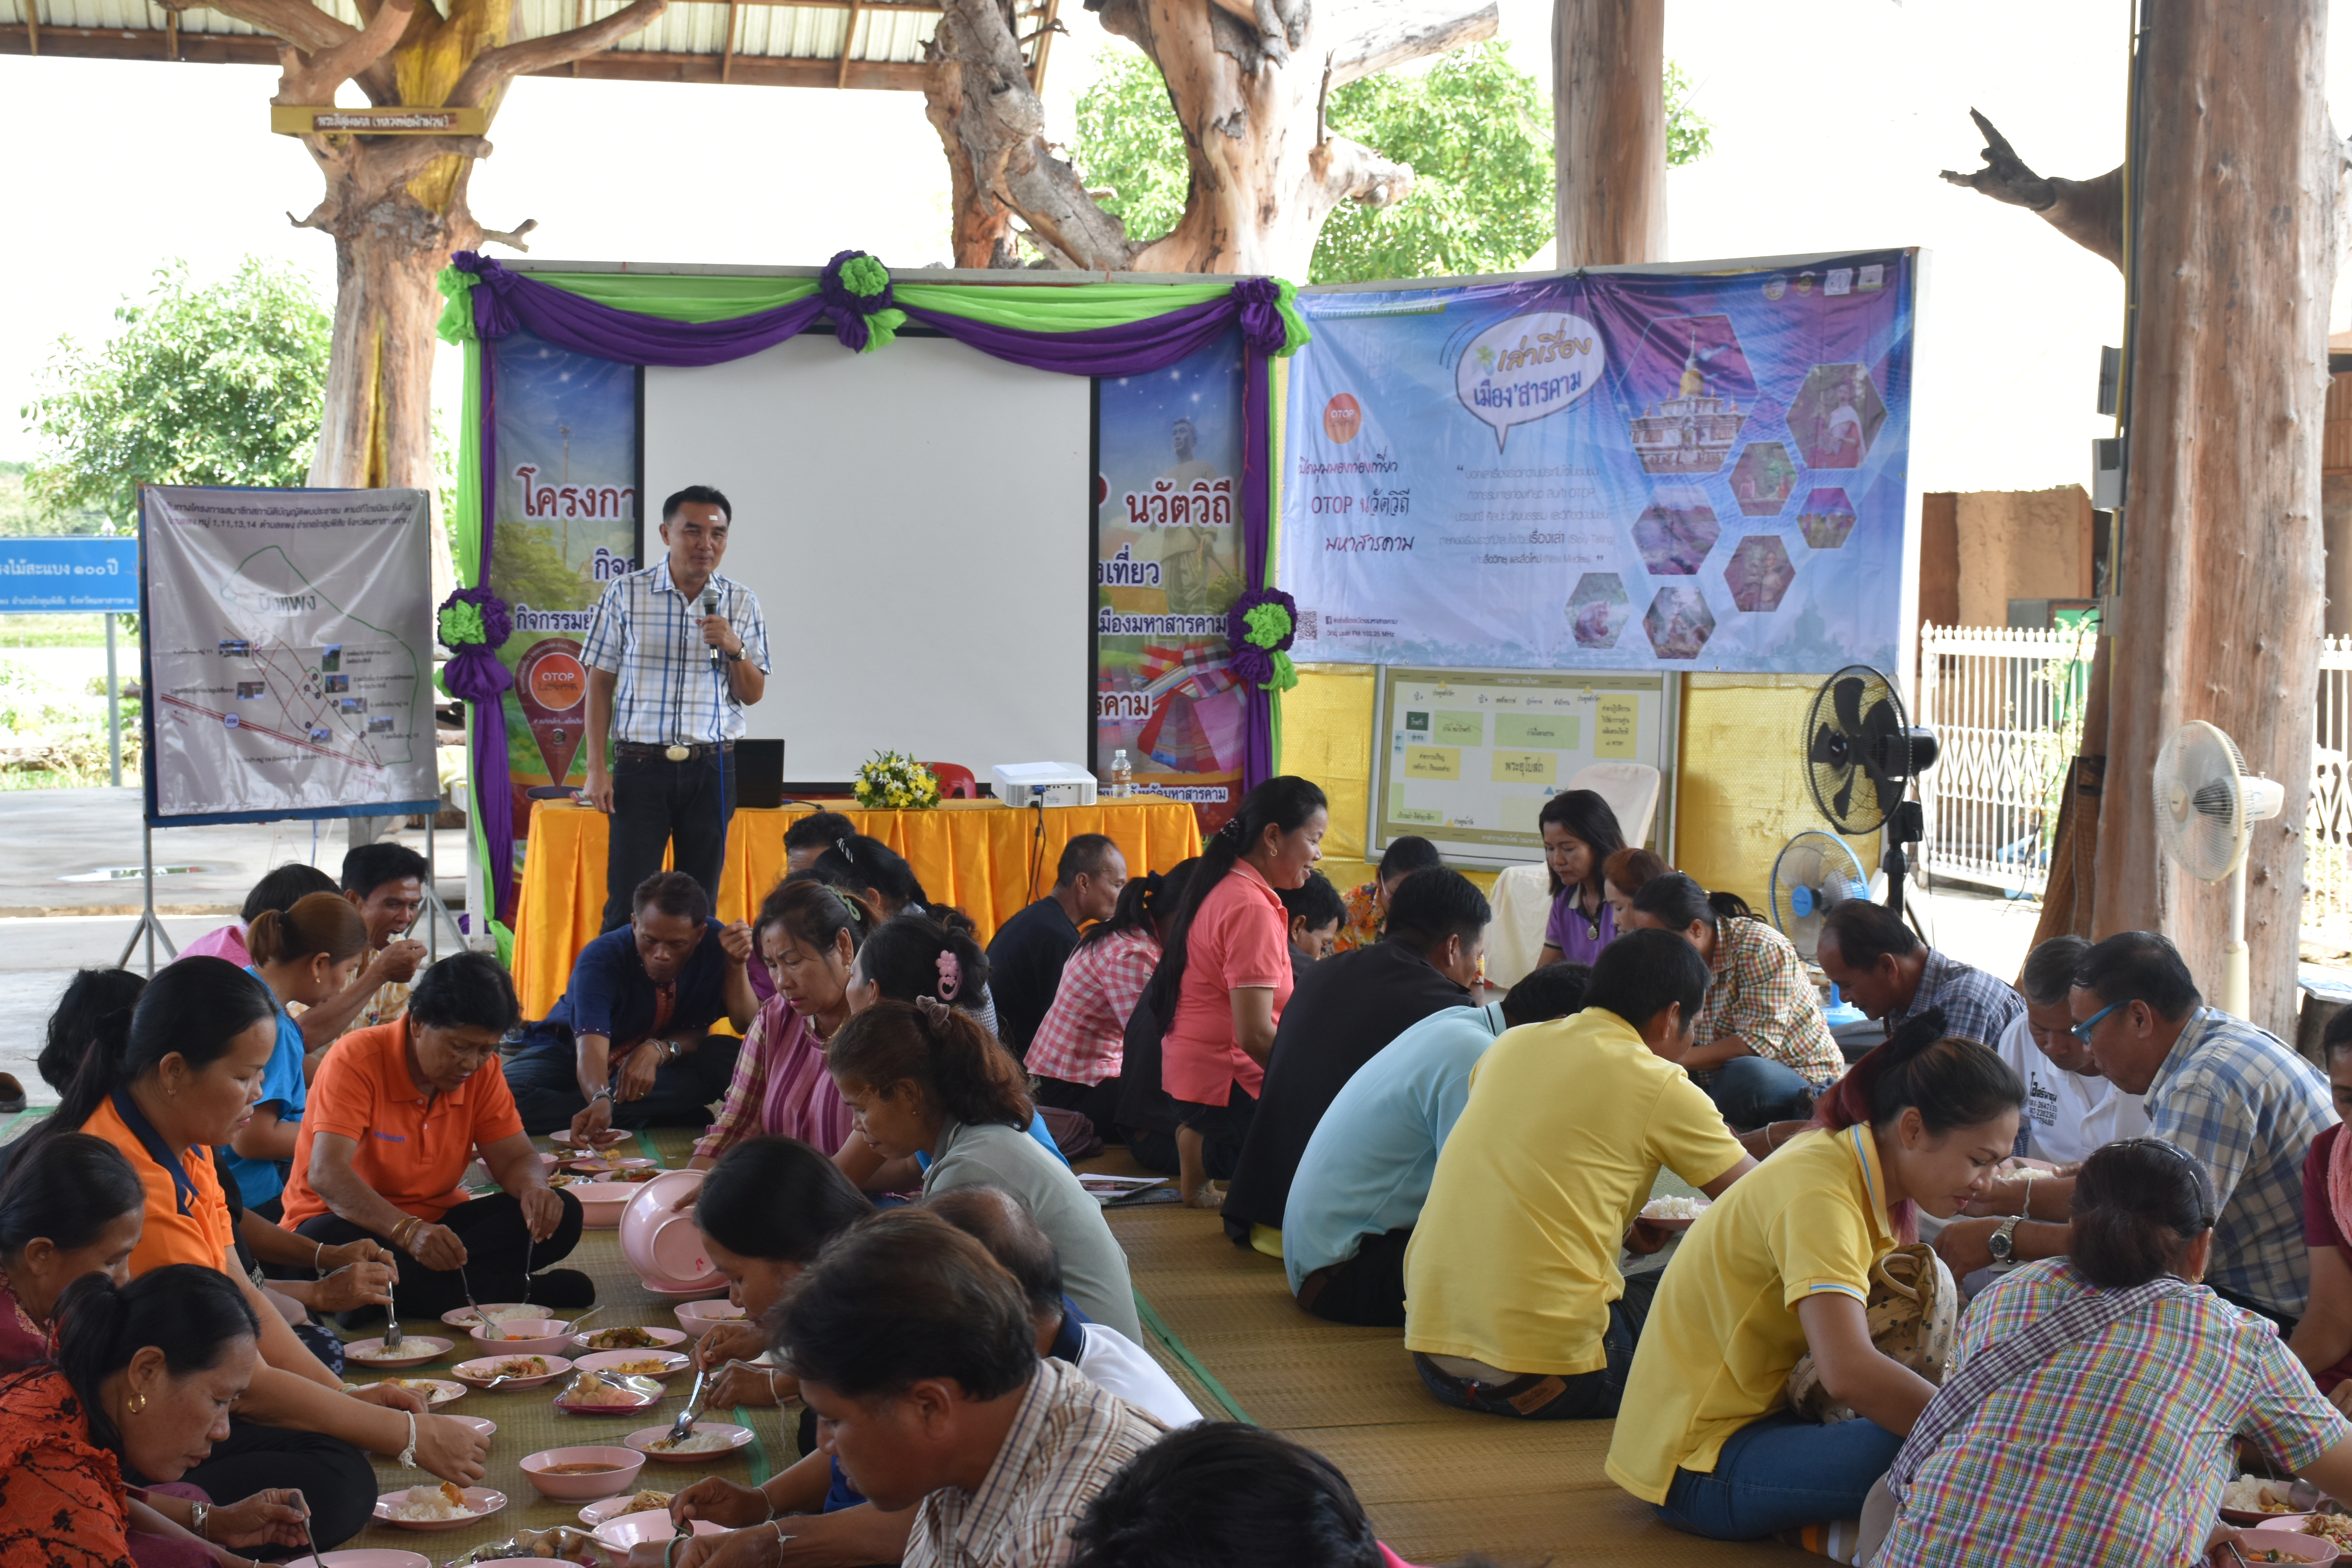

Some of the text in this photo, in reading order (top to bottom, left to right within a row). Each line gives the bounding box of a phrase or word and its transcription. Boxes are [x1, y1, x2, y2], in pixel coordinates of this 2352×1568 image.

[1498, 319, 1591, 372] เล่าเรื่อง
[1126, 480, 1230, 523] นวัตวิถี
[1312, 488, 1410, 516] OTOP นวัตวิถี
[1569, 488, 1595, 498] OTOP
[198, 517, 211, 528] หมู่
[542, 672, 575, 681] OTOP
[1505, 757, 1543, 777] พระอุโบสถ
